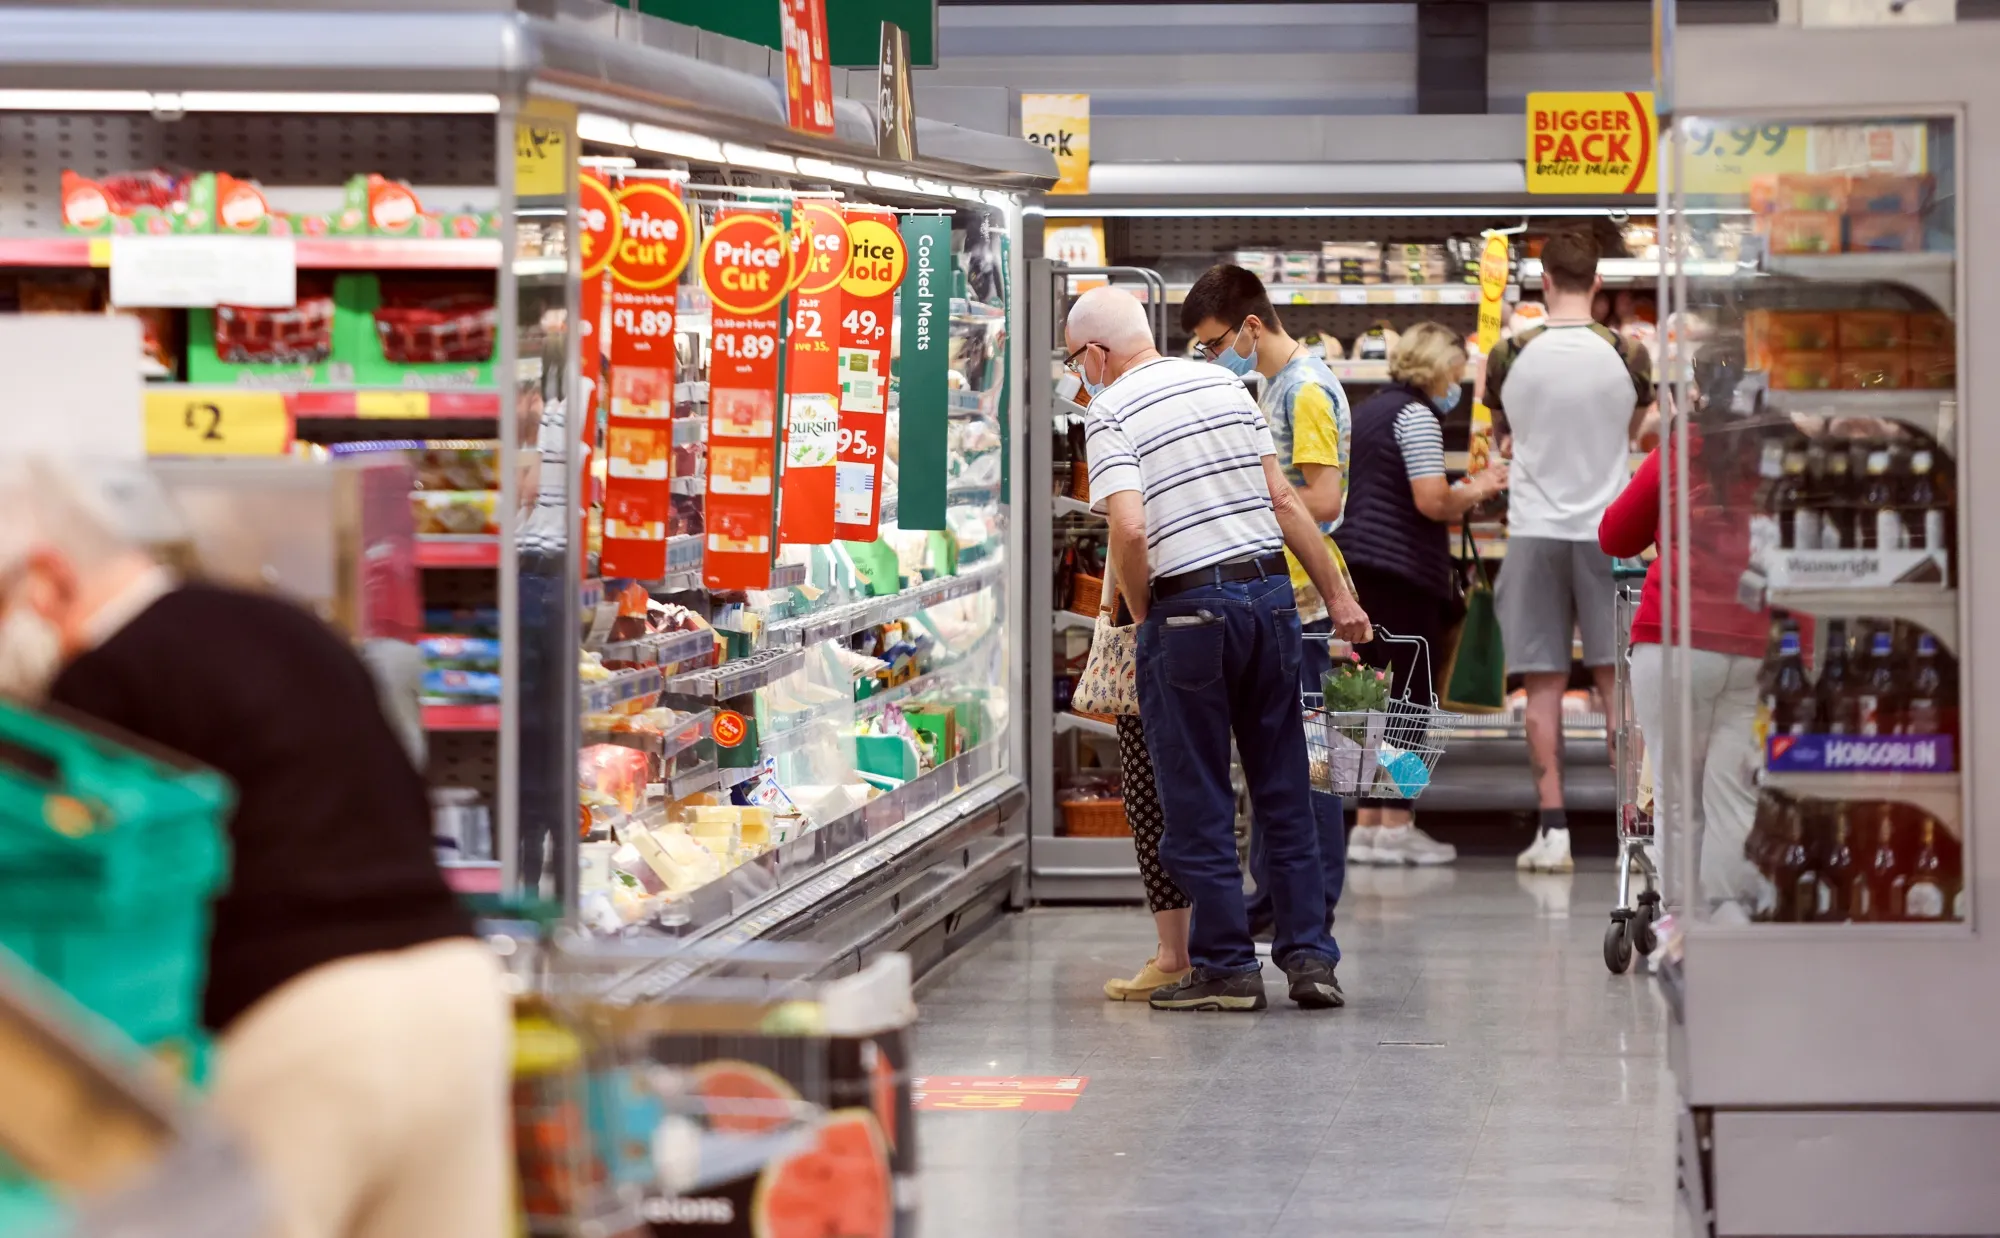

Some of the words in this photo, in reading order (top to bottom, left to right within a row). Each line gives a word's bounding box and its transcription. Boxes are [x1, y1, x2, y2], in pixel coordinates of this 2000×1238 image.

[1535, 110, 1631, 131] BIGGER
[1534, 133, 1632, 163] PACK
[1536, 158, 1580, 177] better
[1585, 159, 1630, 177] value
[619, 238, 670, 266] Cut
[714, 240, 780, 268] Price
[852, 239, 895, 260] rice
[720, 266, 771, 292] Cut
[918, 234, 935, 298] Cooked
[613, 308, 673, 337] £1.89
[795, 310, 823, 338] £2
[841, 310, 885, 340] 49p
[917, 302, 933, 351] Meats
[714, 333, 776, 360] £1.89
[795, 341, 812, 351] ve
[184, 401, 225, 441] £2
[788, 417, 837, 437] oursin
[837, 428, 877, 459] 95p
[720, 718, 739, 735] Price
[1824, 740, 1937, 768] HOBGOBLIN
